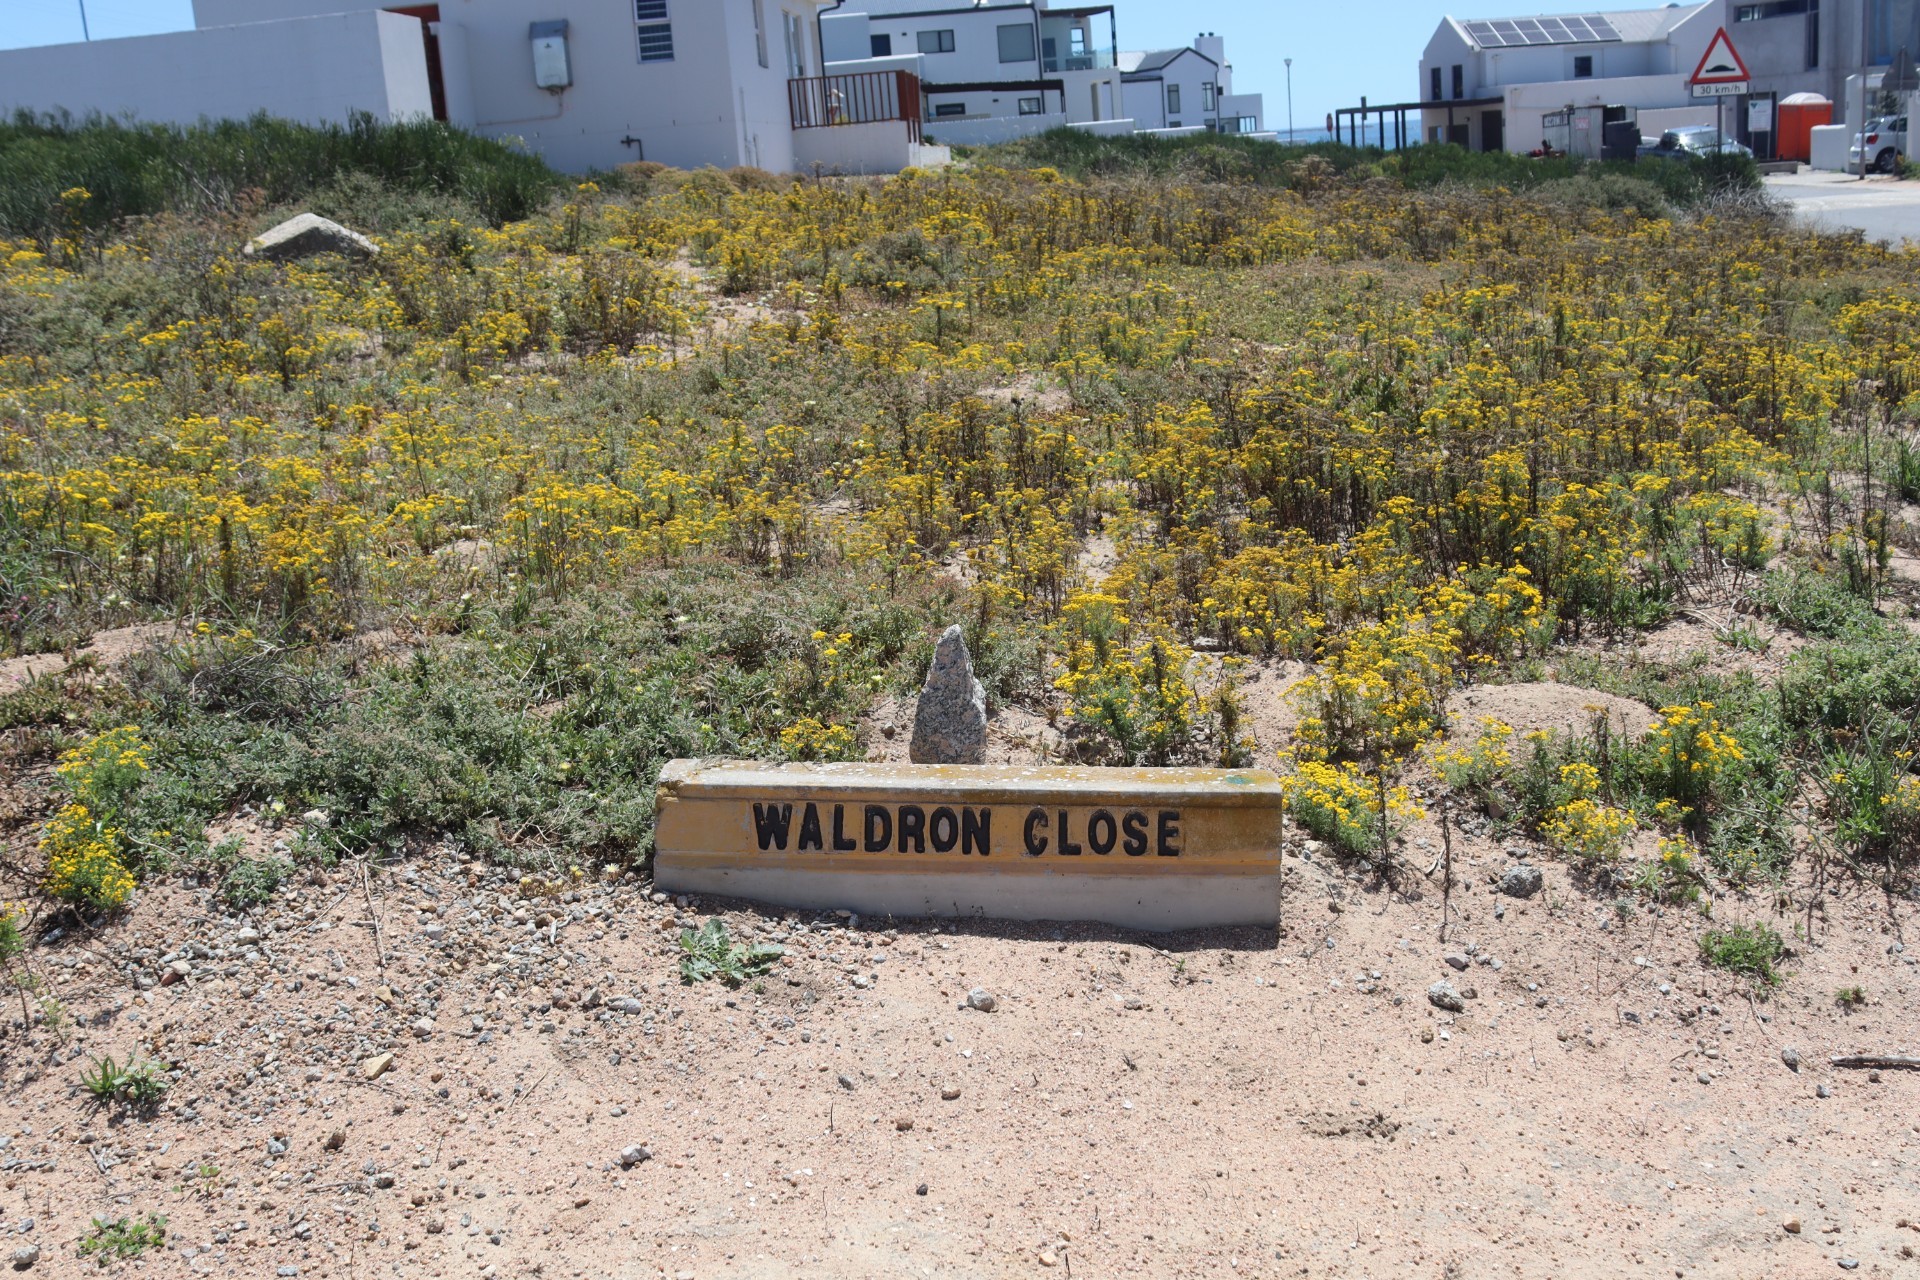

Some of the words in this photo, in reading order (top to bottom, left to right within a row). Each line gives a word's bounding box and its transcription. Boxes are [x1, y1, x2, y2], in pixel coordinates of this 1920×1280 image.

[1700, 85, 1711, 95] 30
[1715, 84, 1740, 94] km/h
[753, 802, 992, 856] WALDRON
[1023, 807, 1181, 857] CLOSE
